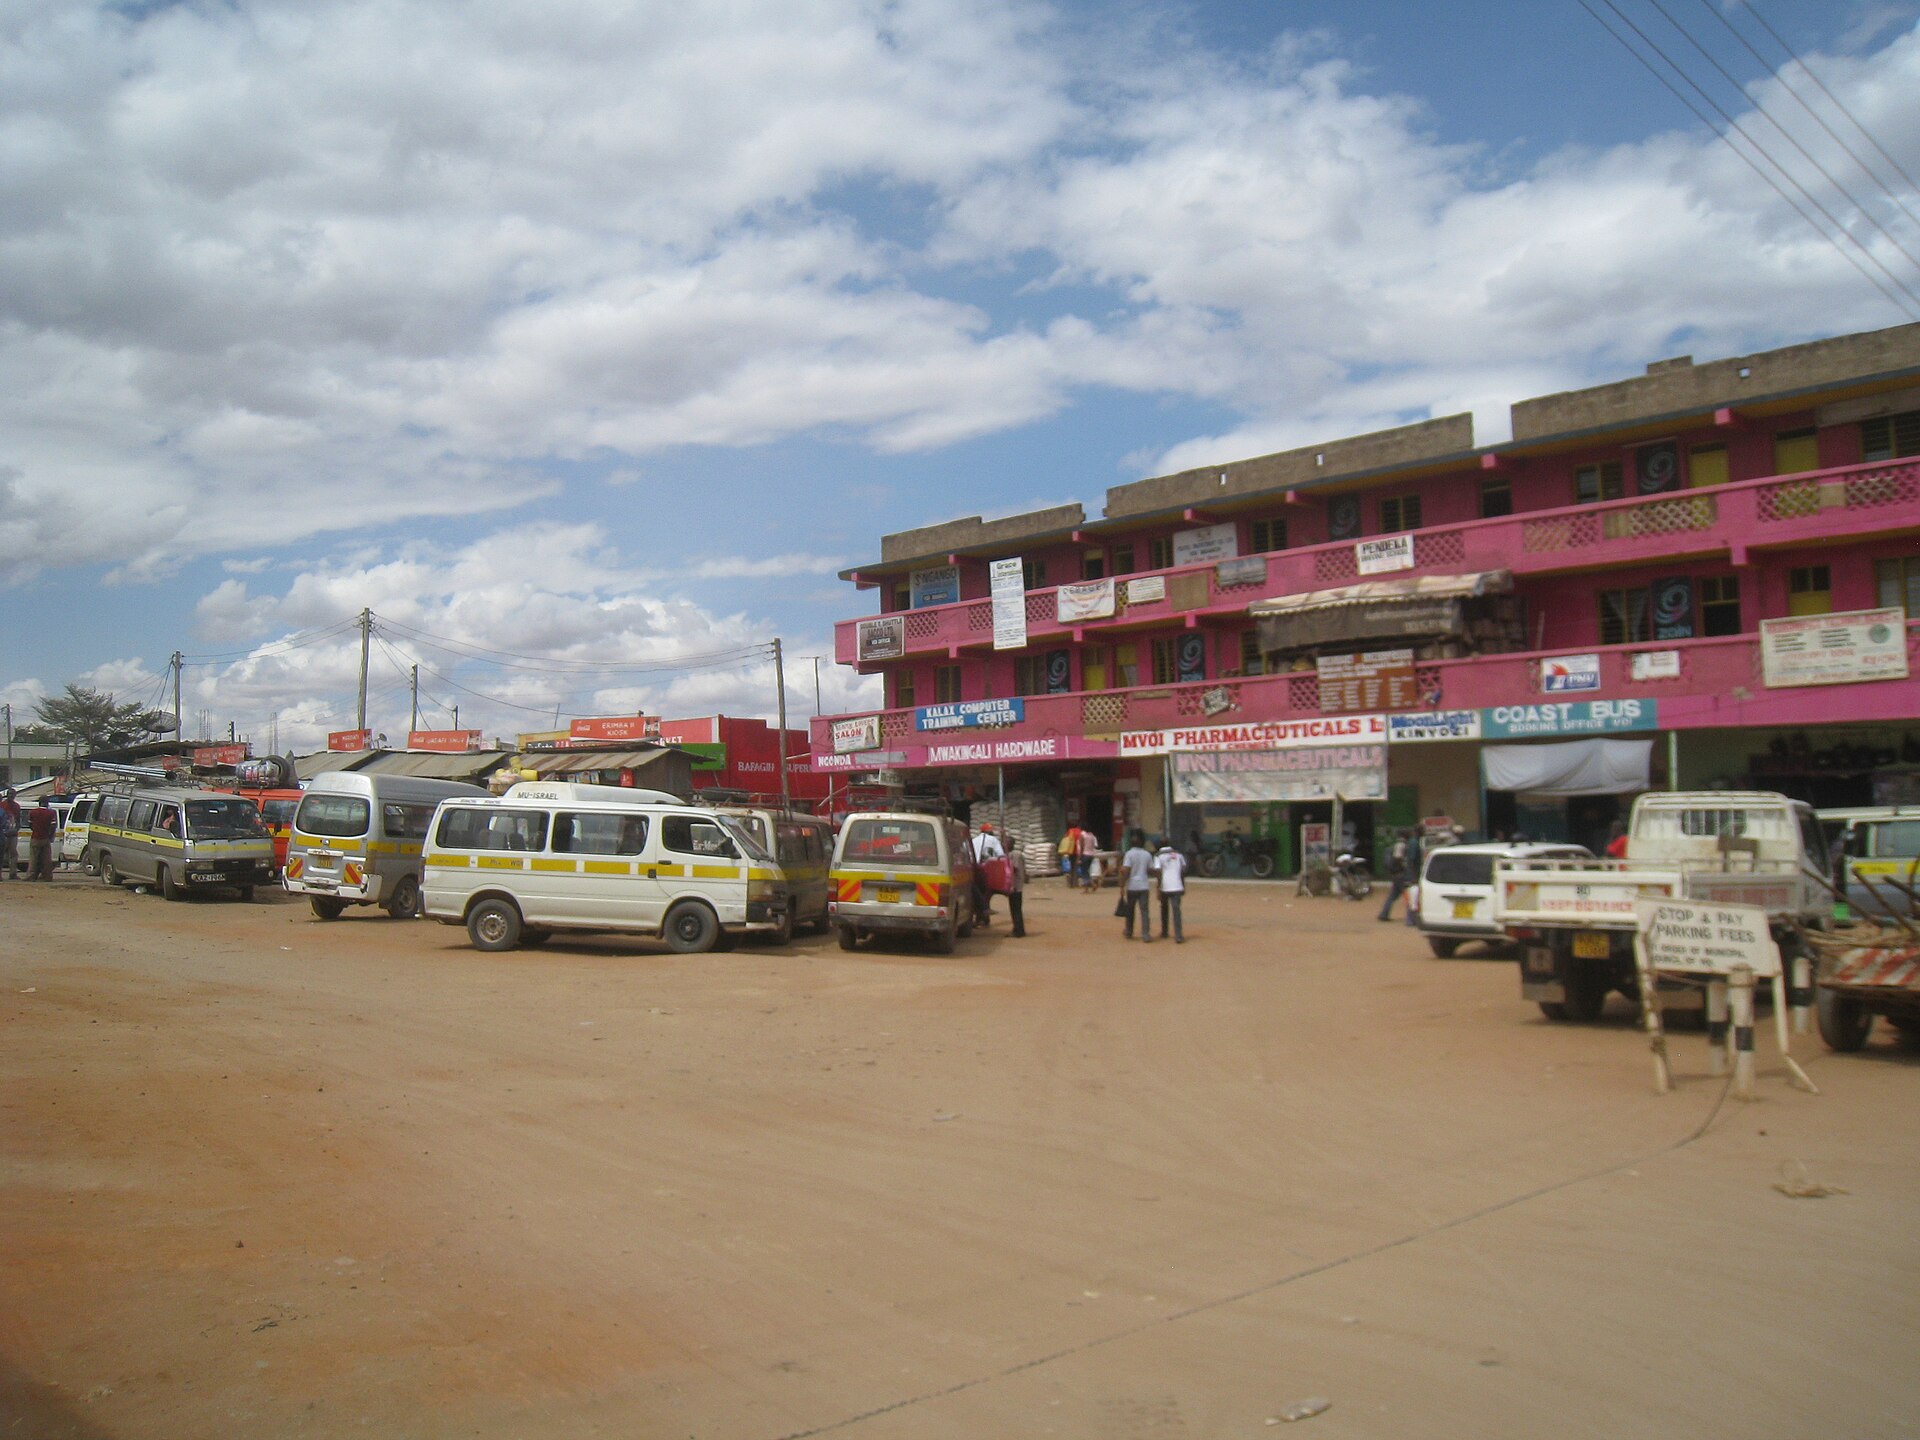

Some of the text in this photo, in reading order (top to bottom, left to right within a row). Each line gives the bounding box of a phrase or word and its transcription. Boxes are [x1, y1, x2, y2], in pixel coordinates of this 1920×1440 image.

[959, 699, 1010, 715] COMPUTER
[1492, 699, 1642, 724] COAST BUS
[922, 709, 1017, 730] TRAINING CENTER
[1508, 720, 1558, 734] BOOKING
[1563, 718, 1605, 731] OFFICE
[836, 727, 863, 740] SALON
[1122, 732, 1165, 749] MVOI
[1173, 719, 1361, 746] PHARMACEUTICALS
[930, 739, 1056, 762] MWAKINGALI HARDWARE
[1219, 746, 1382, 773] PHARMACEUTICALS
[817, 755, 851, 767] NGONDA
[516, 791, 559, 801] MU-ISRAEL
[1658, 906, 1694, 922] STOP
[1718, 911, 1744, 925] PAY
[1656, 923, 1756, 943] PARKING FEES
